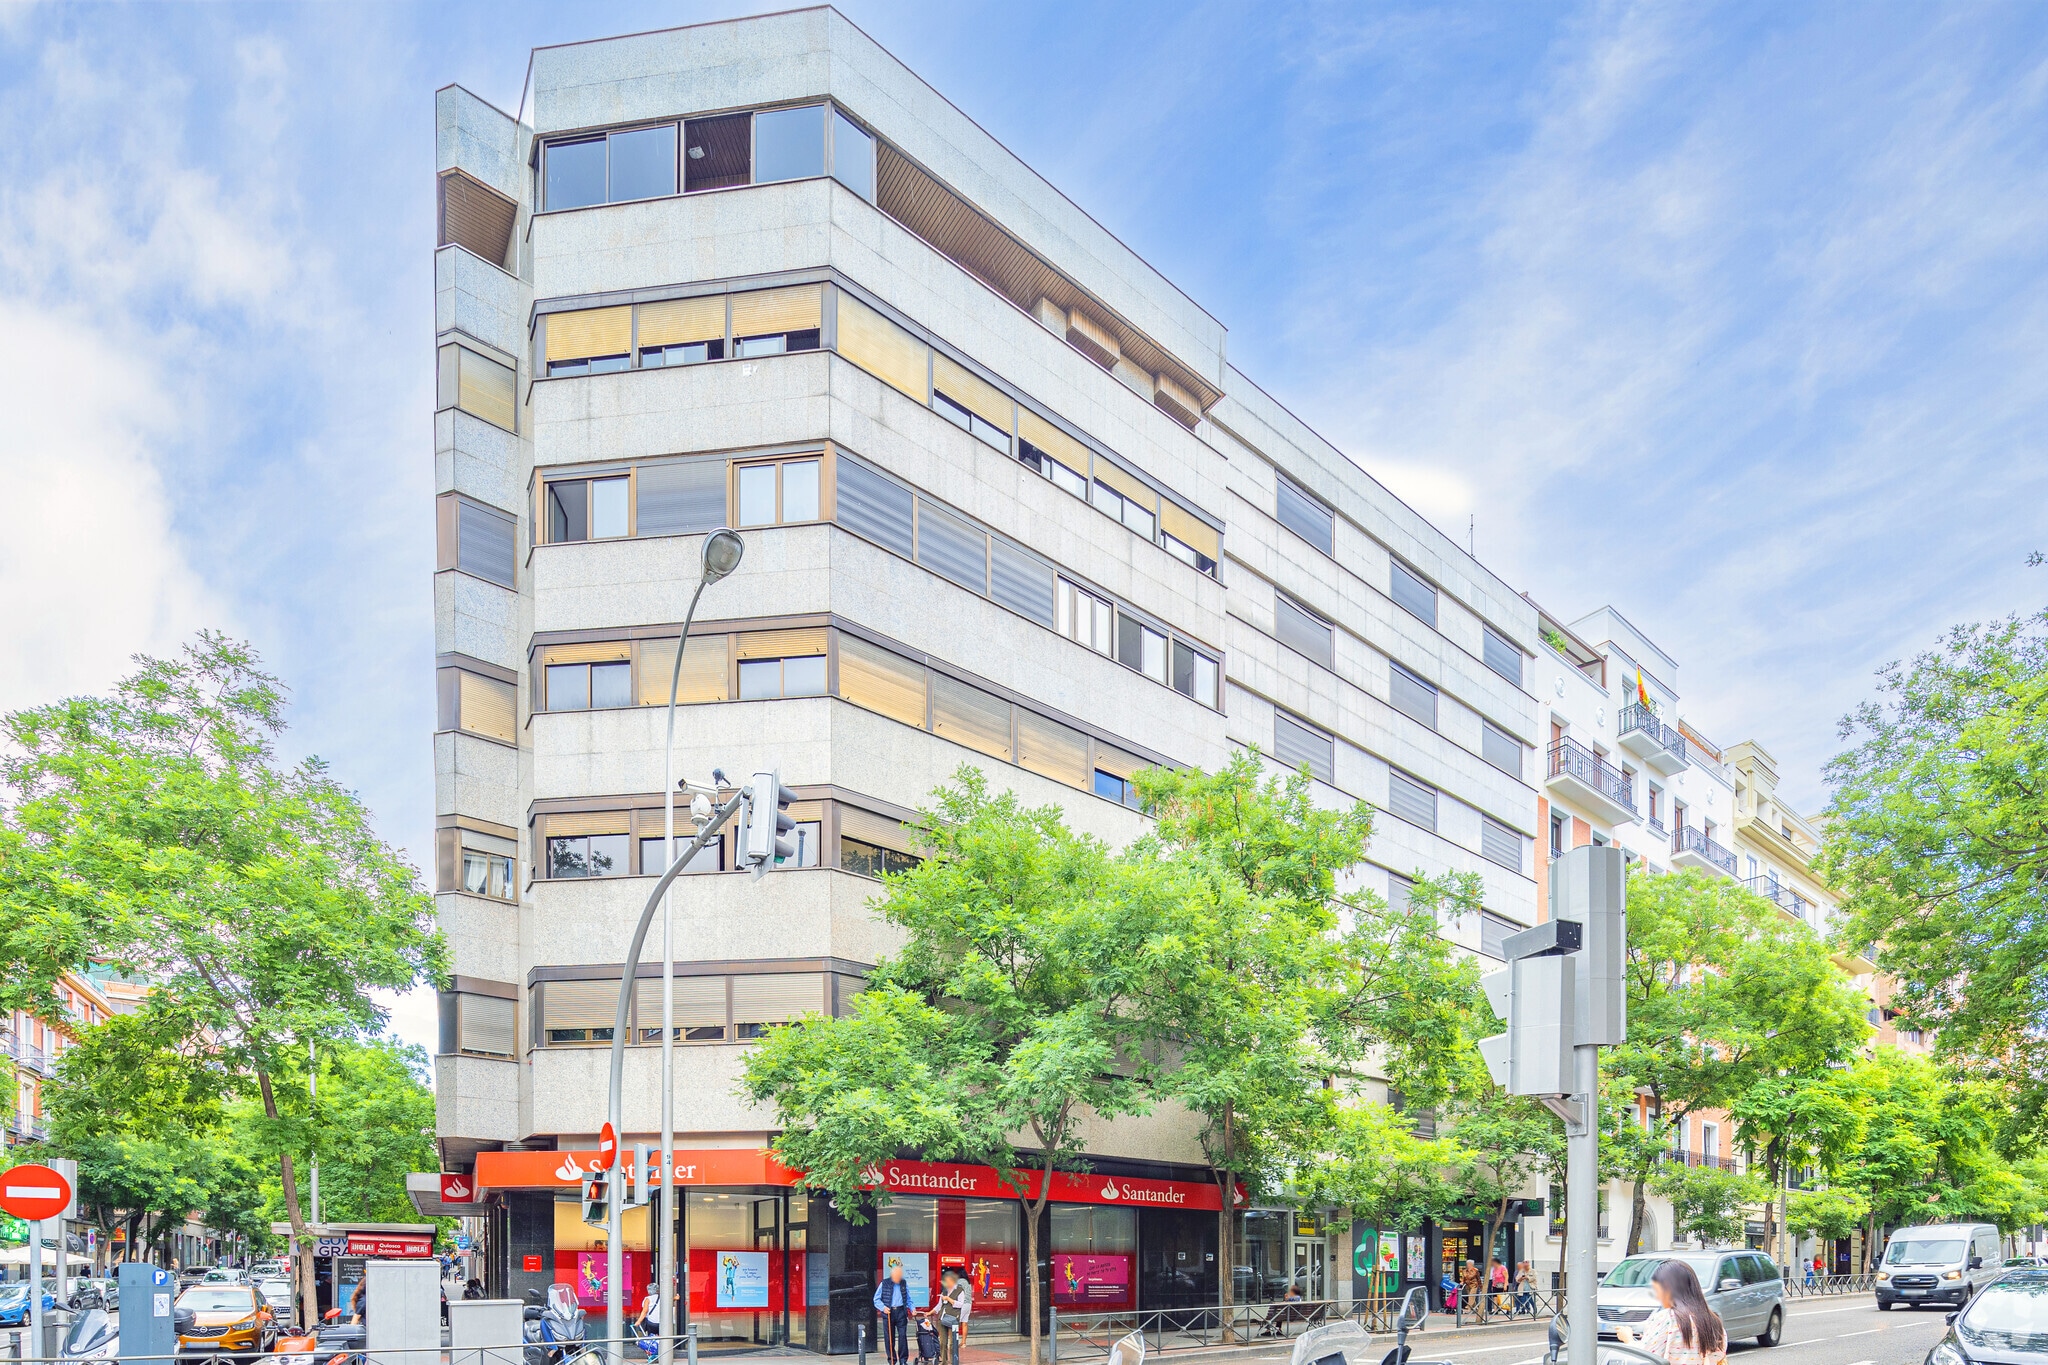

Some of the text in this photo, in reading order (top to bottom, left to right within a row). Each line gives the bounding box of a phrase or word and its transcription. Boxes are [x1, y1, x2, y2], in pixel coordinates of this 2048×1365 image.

[889, 1166, 977, 1191] Santander
[1122, 1183, 1186, 1204] Santander
[155, 1271, 166, 1285] P
